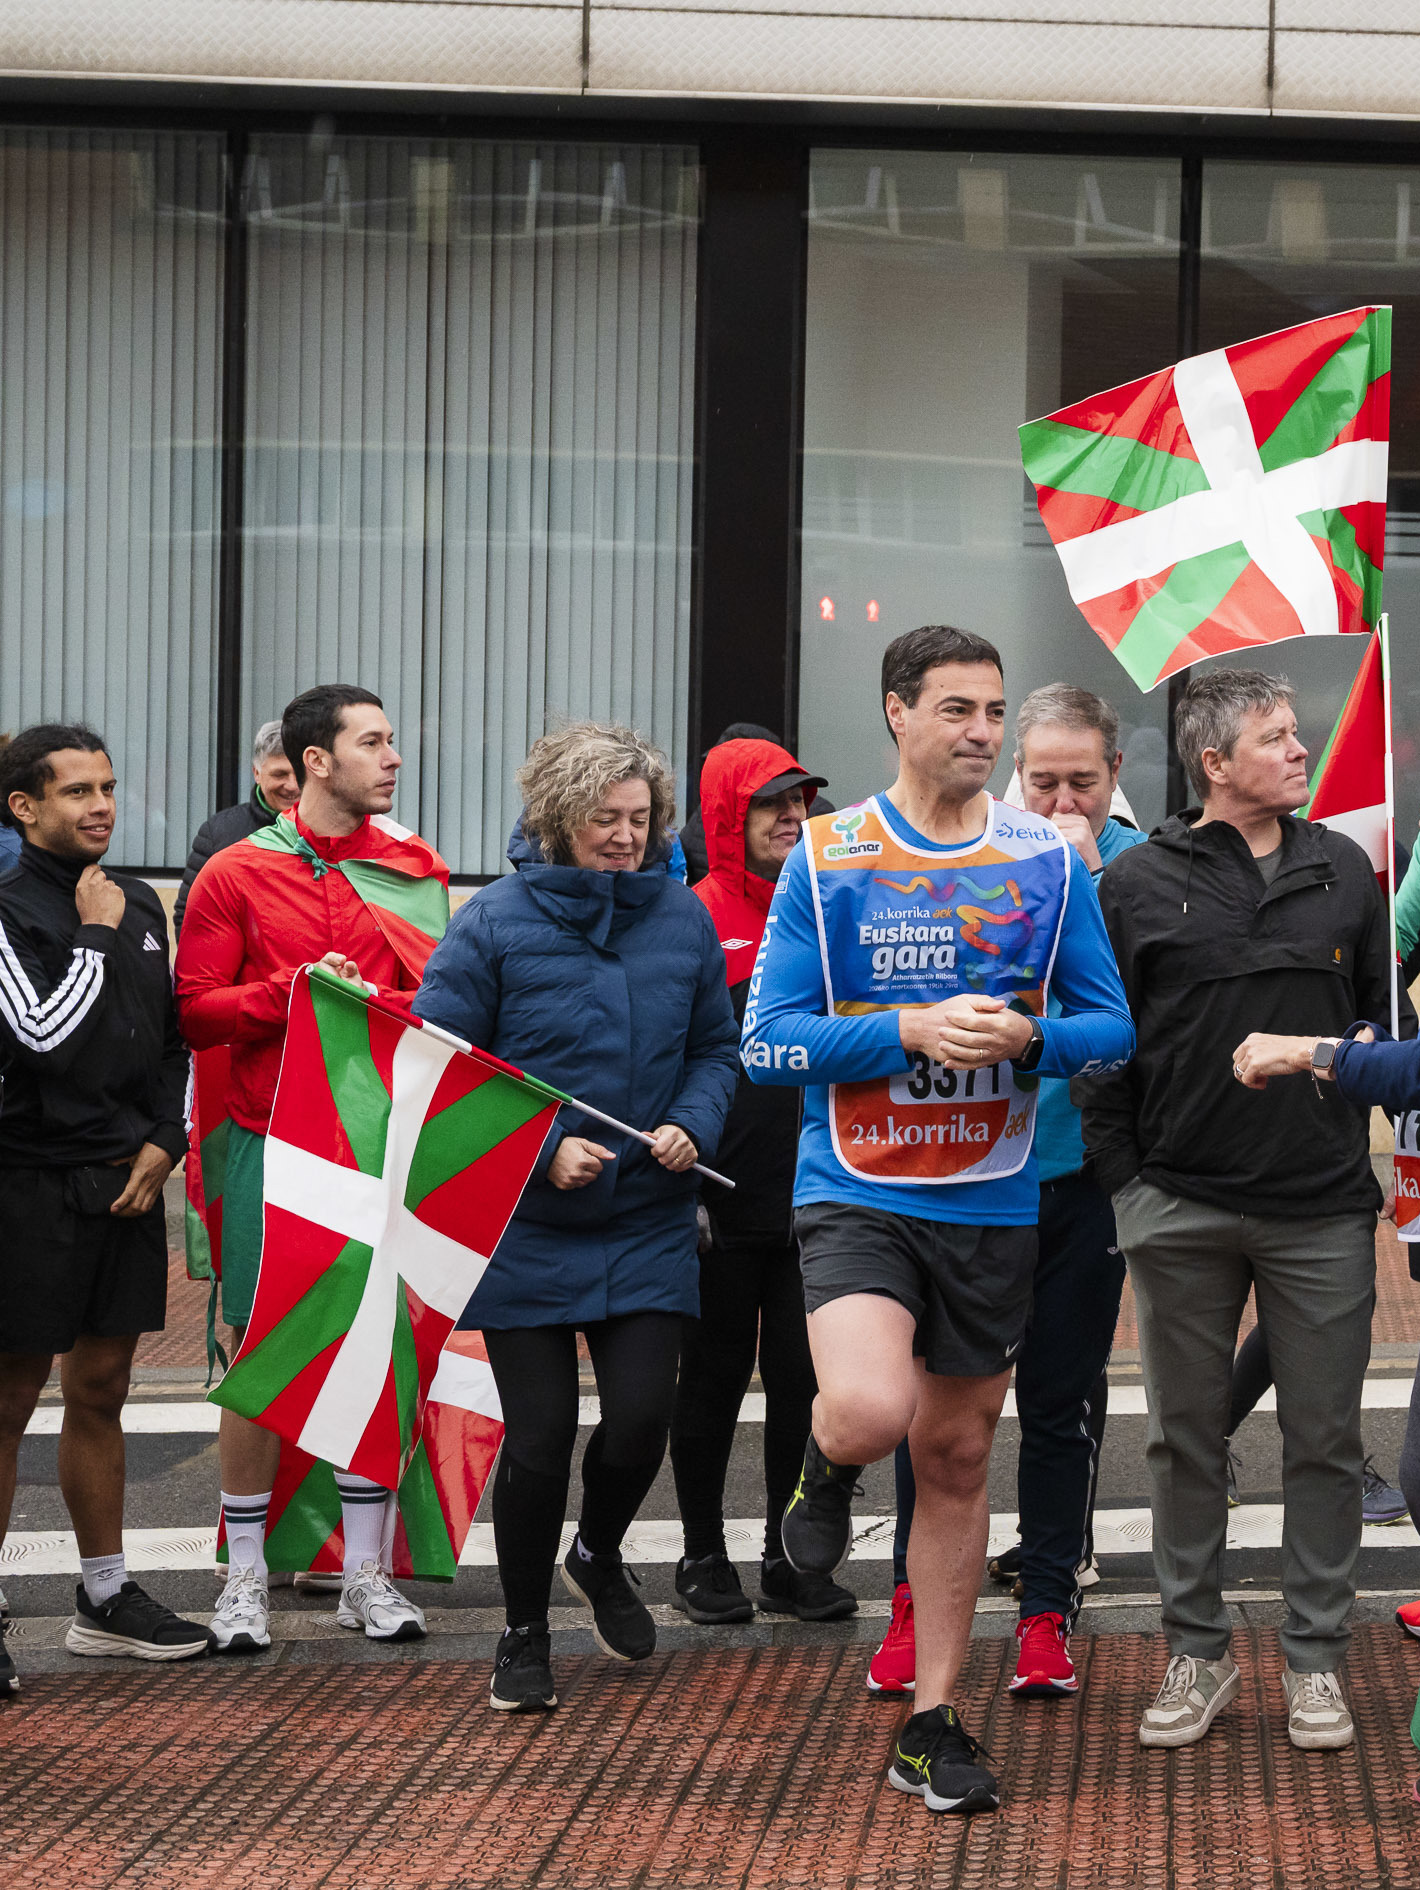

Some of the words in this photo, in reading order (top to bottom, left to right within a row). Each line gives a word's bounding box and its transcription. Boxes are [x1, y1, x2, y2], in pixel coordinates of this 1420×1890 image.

[1016, 828, 1057, 842] eitb
[871, 906, 931, 921] 24.korrika
[859, 922, 954, 945] Euskara
[872, 944, 956, 980] gara
[851, 1114, 990, 1146] 24.korrika
[1004, 1103, 1031, 1140] aek
